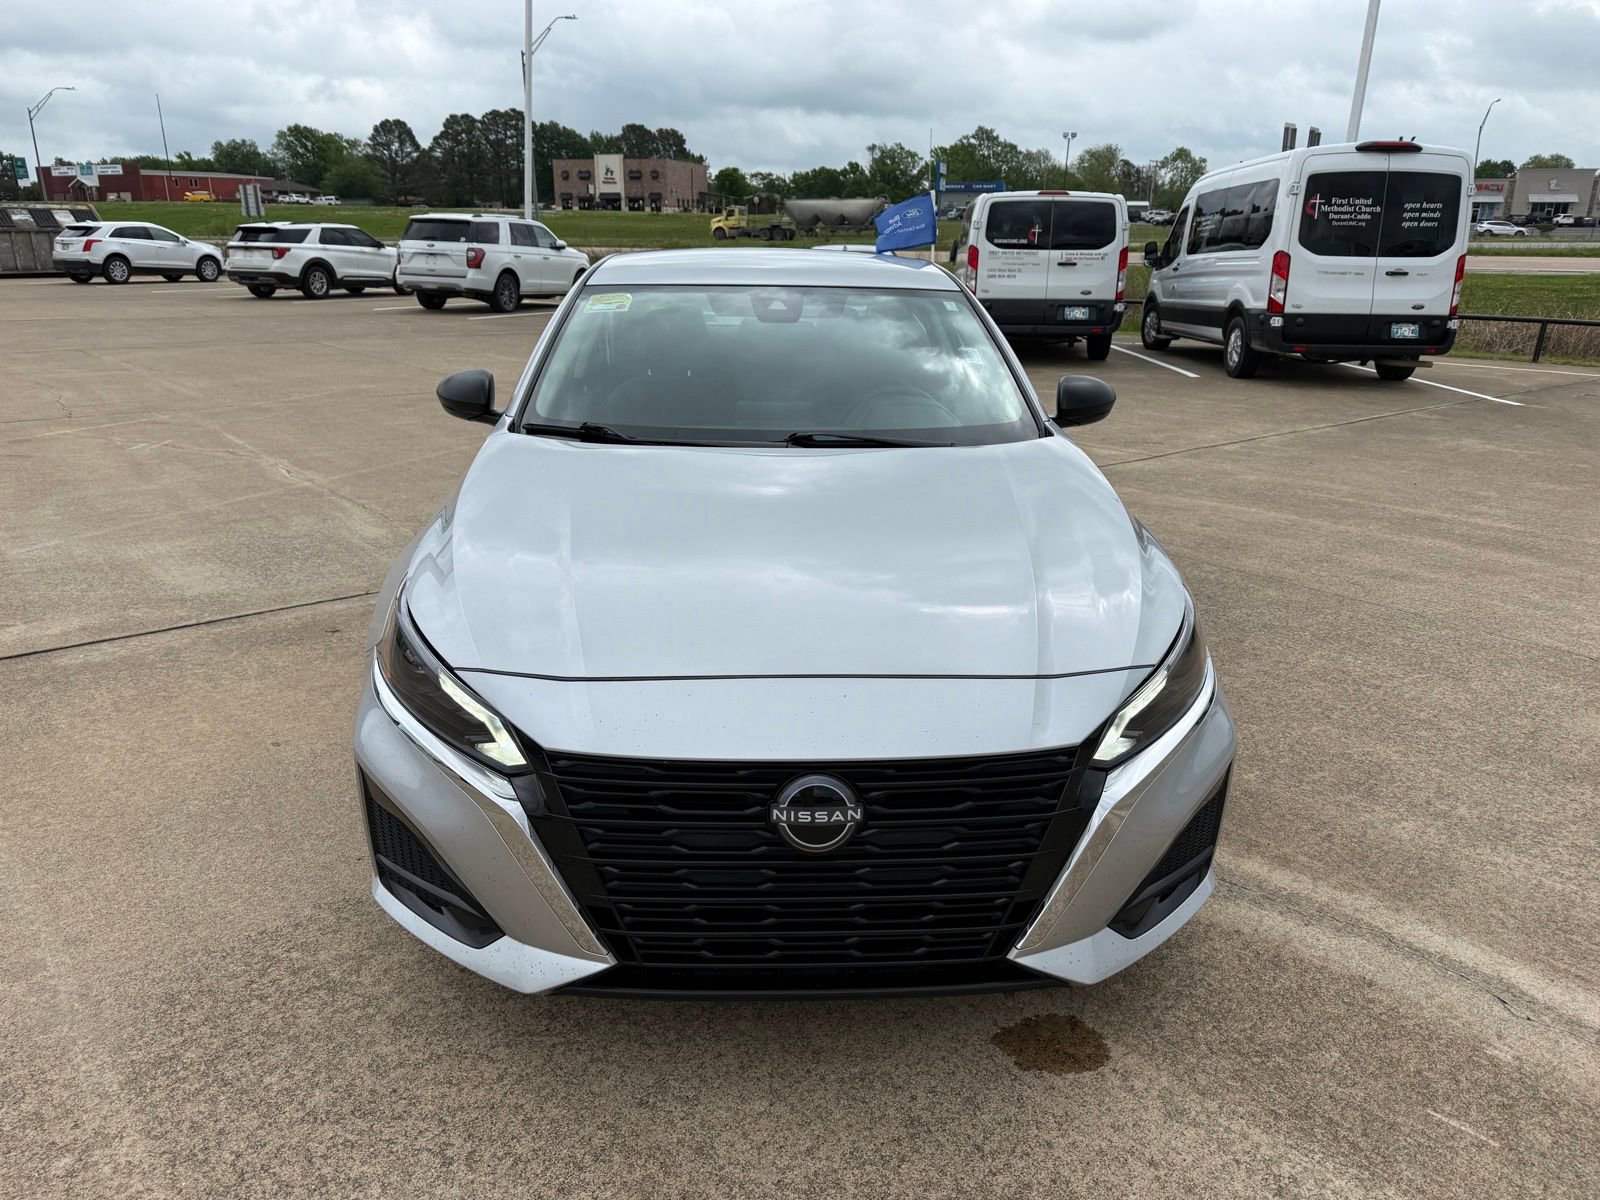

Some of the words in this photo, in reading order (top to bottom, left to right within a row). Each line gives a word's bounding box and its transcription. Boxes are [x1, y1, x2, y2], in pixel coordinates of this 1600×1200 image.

[1331, 197, 1348, 205] First
[1349, 197, 1372, 205] United
[1422, 201, 1443, 209] hearts
[1355, 205, 1381, 213] Church
[1421, 210, 1441, 218] minds
[1419, 219, 1438, 227] doors
[772, 808, 861, 823] NISSAN
